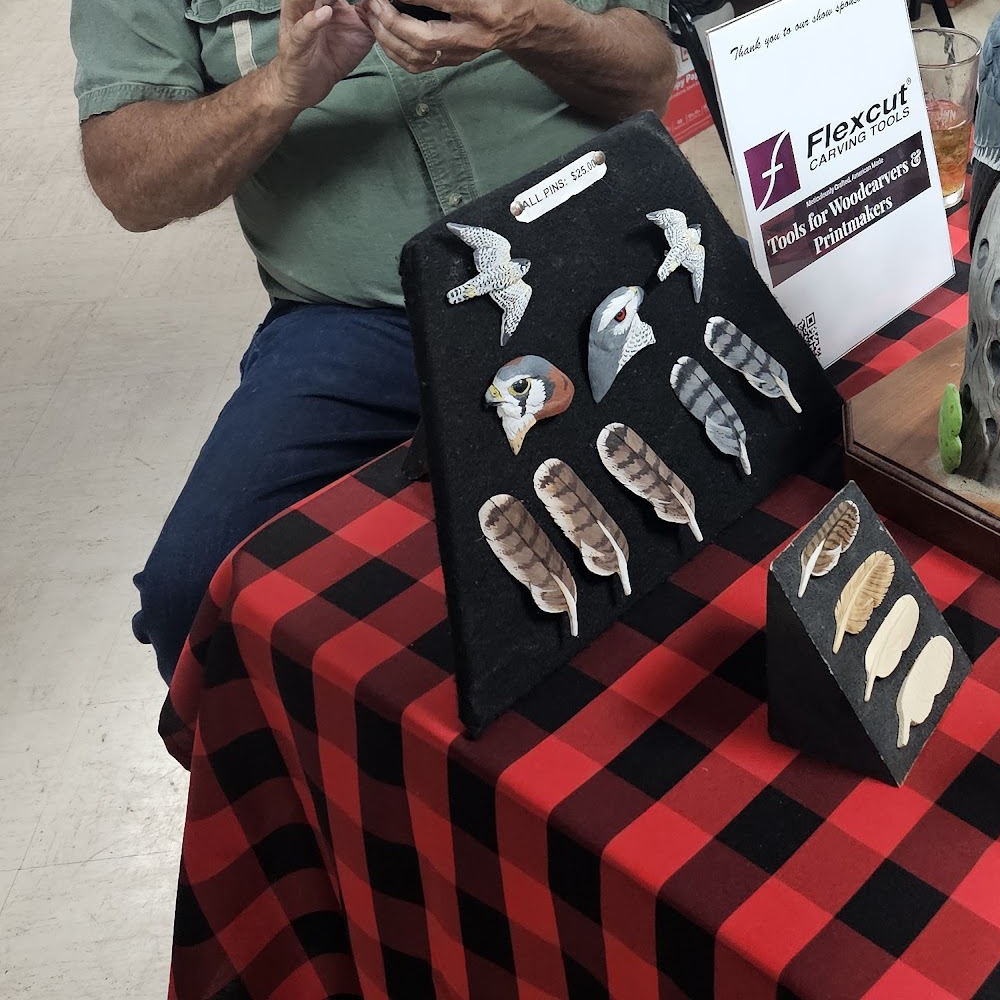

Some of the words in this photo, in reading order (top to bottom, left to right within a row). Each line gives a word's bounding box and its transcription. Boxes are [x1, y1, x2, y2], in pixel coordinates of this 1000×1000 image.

[729, 37, 762, 61] Thank
[764, 32, 780, 48] you
[782, 26, 793, 38] to
[794, 20, 810, 32] our
[811, 8, 833, 24] show
[809, 131, 866, 172] CARVING
[870, 106, 910, 136] TOOLS
[521, 193, 543, 210] ALL
[543, 178, 568, 198] PINS:
[570, 159, 597, 181] $25.00
[767, 221, 807, 256] Tools
[807, 207, 829, 233] for
[828, 159, 909, 217] Woodcarvers
[910, 148, 922, 167] &
[805, 186, 834, 208] Meticulously
[851, 164, 873, 181] American
[870, 157, 884, 169] Made
[813, 196, 893, 255] Printmakers
